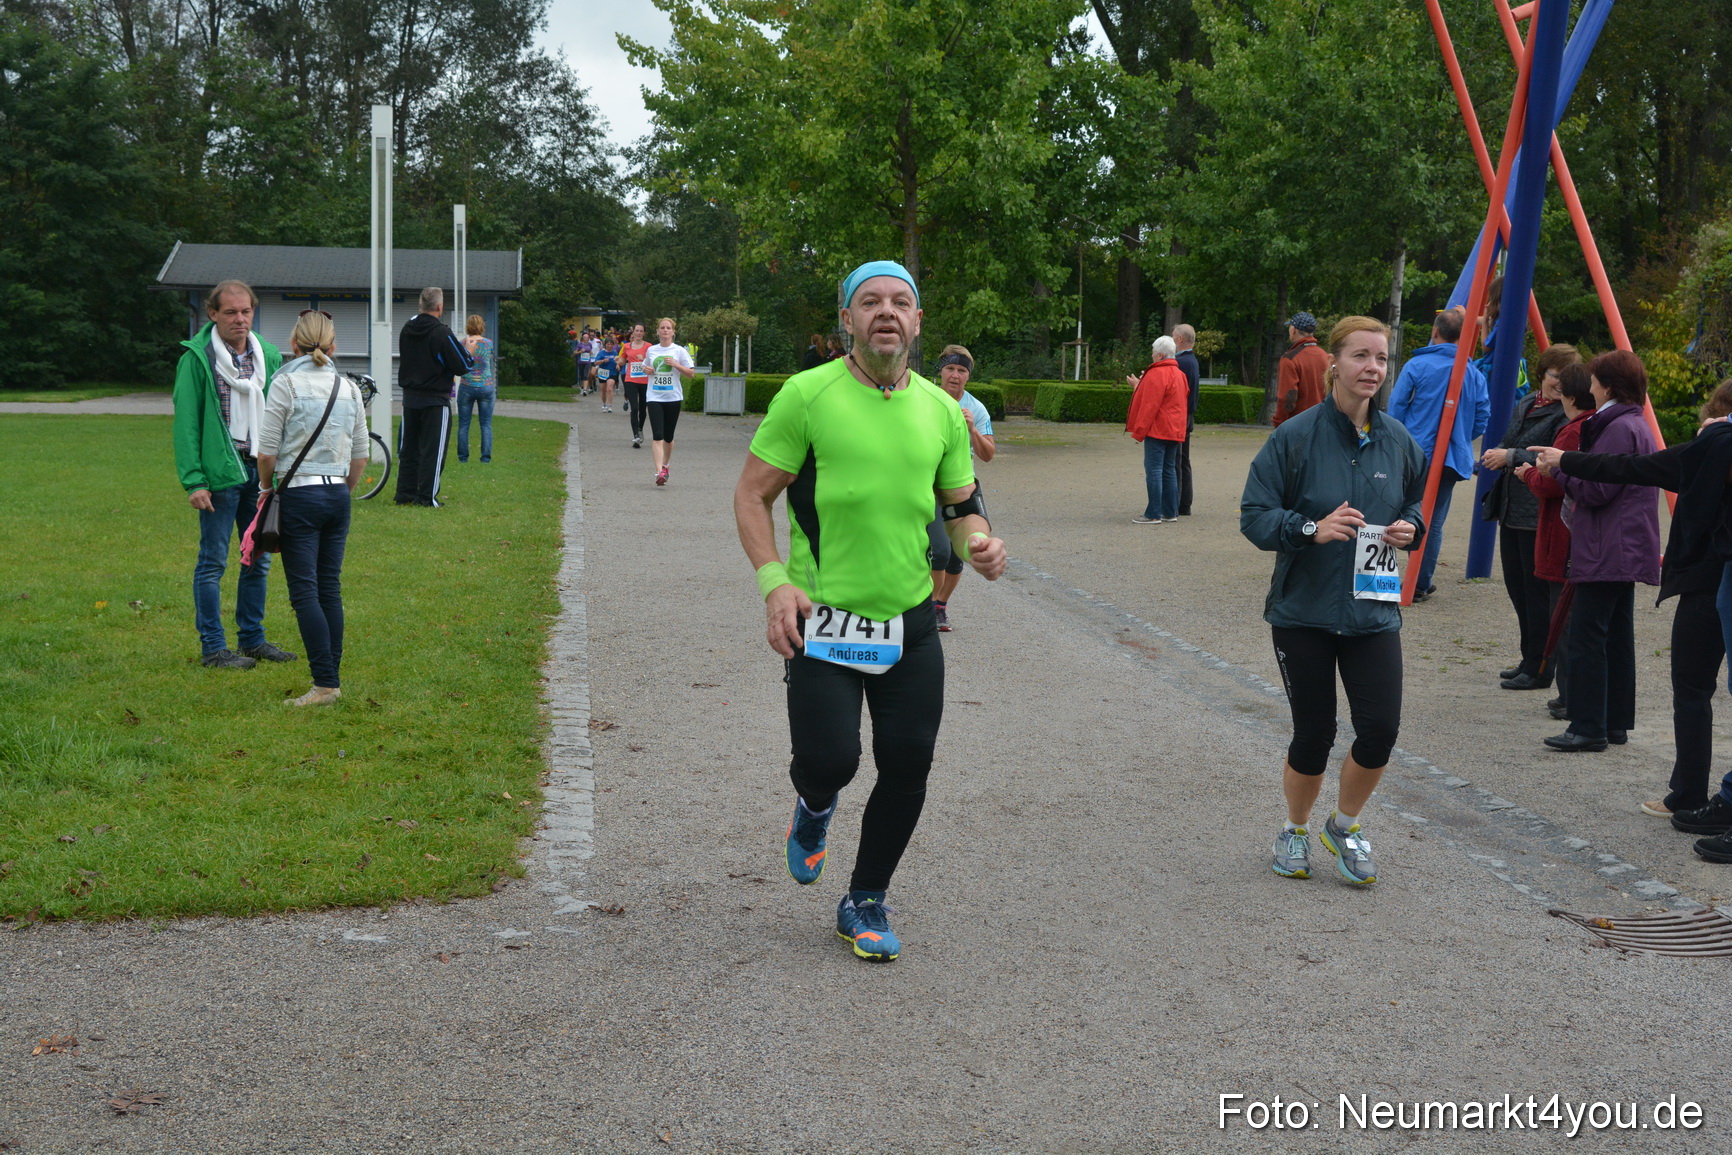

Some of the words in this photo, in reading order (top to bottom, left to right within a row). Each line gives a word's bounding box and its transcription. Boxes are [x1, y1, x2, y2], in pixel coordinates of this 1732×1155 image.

[654, 376, 672, 385] 2488
[1359, 531, 1383, 541] PART
[1364, 543, 1398, 573] 248
[1376, 579, 1396, 591] Marika
[815, 605, 890, 640] 2741
[827, 647, 879, 662] Andreas
